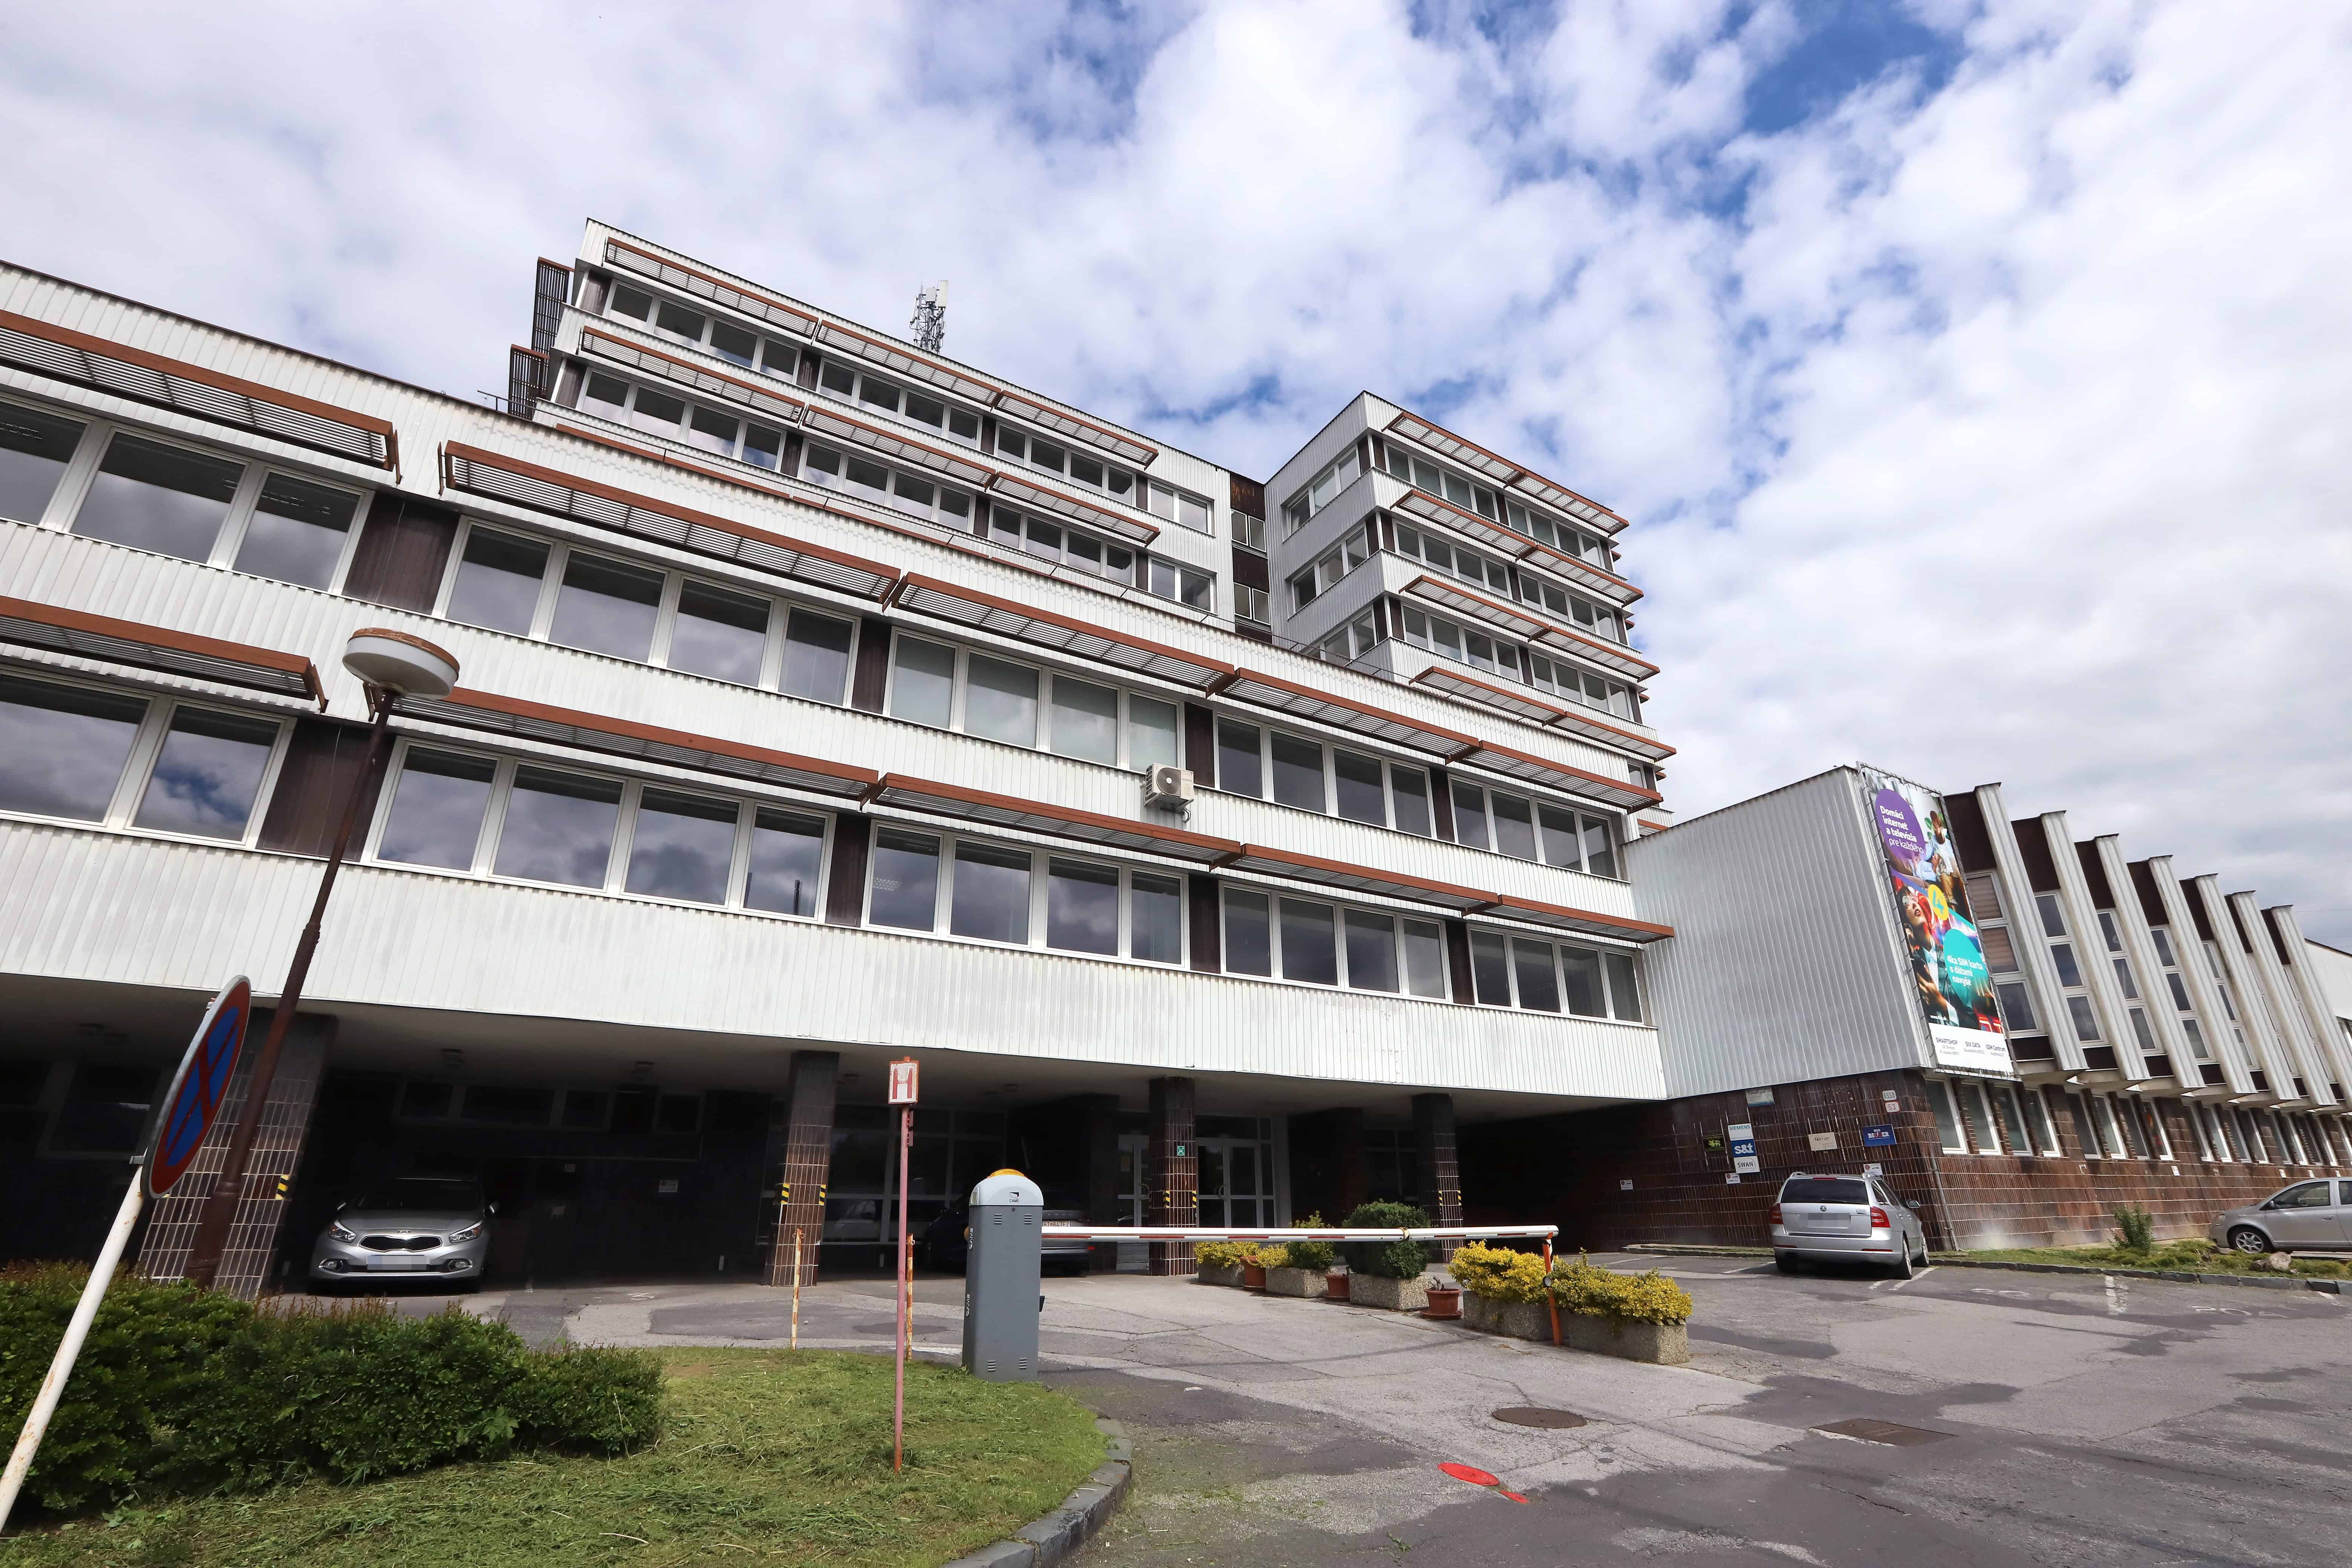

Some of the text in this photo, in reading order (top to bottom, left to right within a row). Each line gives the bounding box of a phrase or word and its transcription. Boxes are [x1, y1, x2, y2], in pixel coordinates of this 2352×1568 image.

[1879, 805, 1904, 820] Domáci
[1882, 815, 1909, 830] internet
[1891, 828, 1917, 842] televízia
[1889, 838, 1900, 847] pre
[1957, 957, 1969, 967] SIM
[1734, 1142, 1754, 1155] s&t
